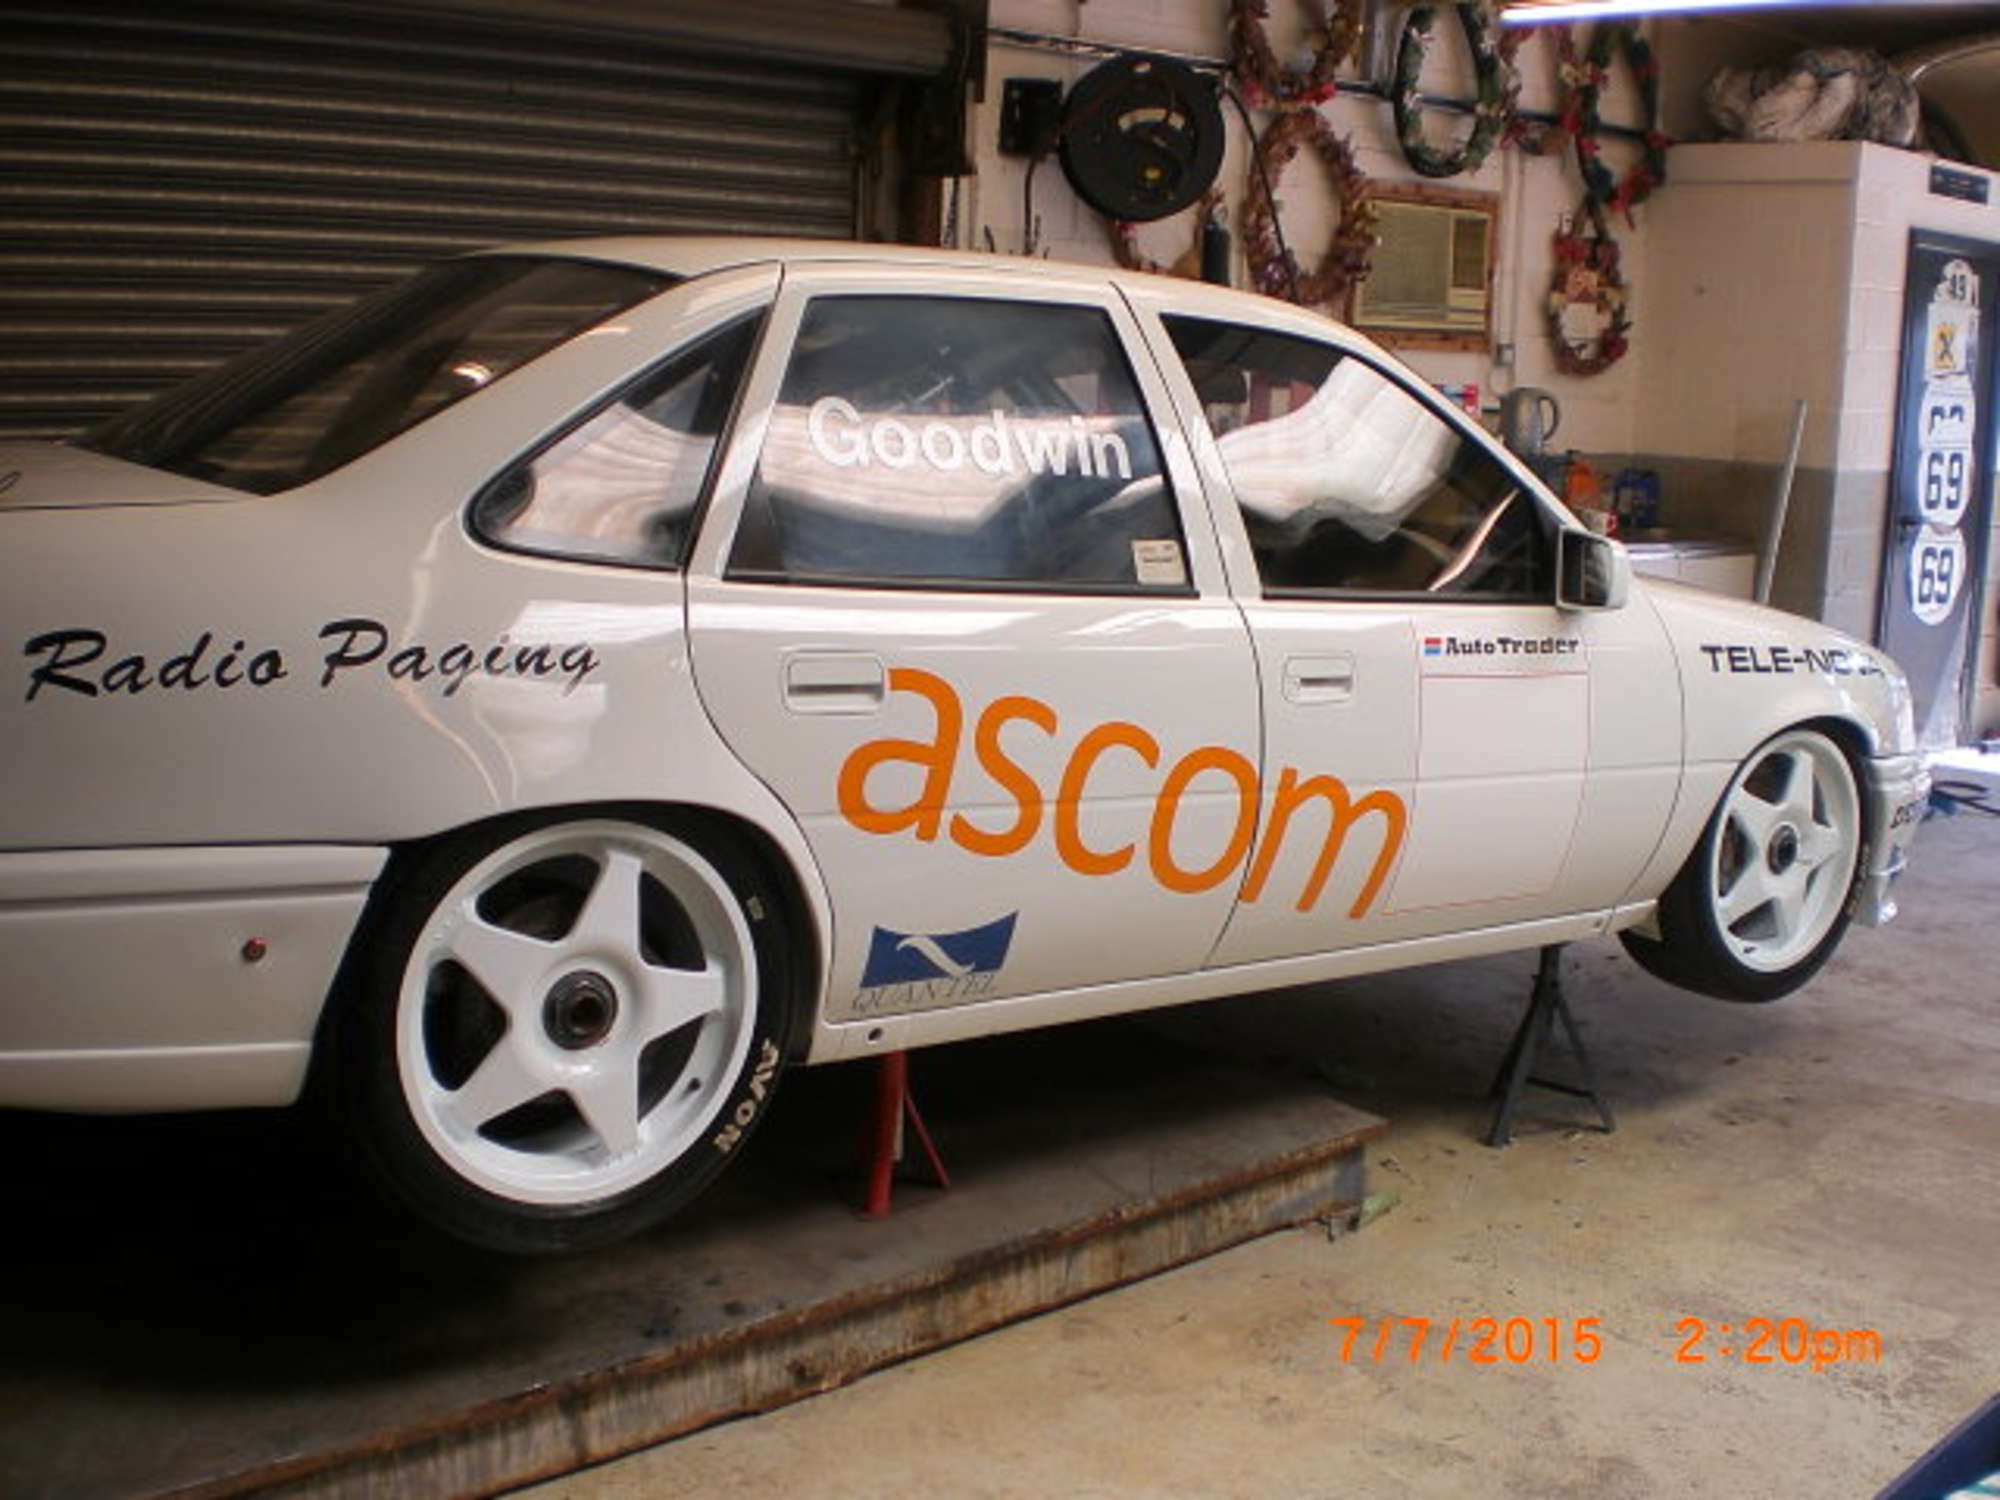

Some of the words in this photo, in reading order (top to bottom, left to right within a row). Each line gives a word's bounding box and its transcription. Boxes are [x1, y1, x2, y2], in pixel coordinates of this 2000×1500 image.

[807, 396, 1132, 479] Goodwin
[1925, 452, 1964, 509] 69
[1919, 547, 1954, 603] 69
[24, 629, 288, 701] Radio
[318, 618, 599, 697] Paging
[1700, 645, 1886, 677] TELE-NO
[837, 667, 1407, 919] ascom
[713, 1037, 780, 1152] AVON
